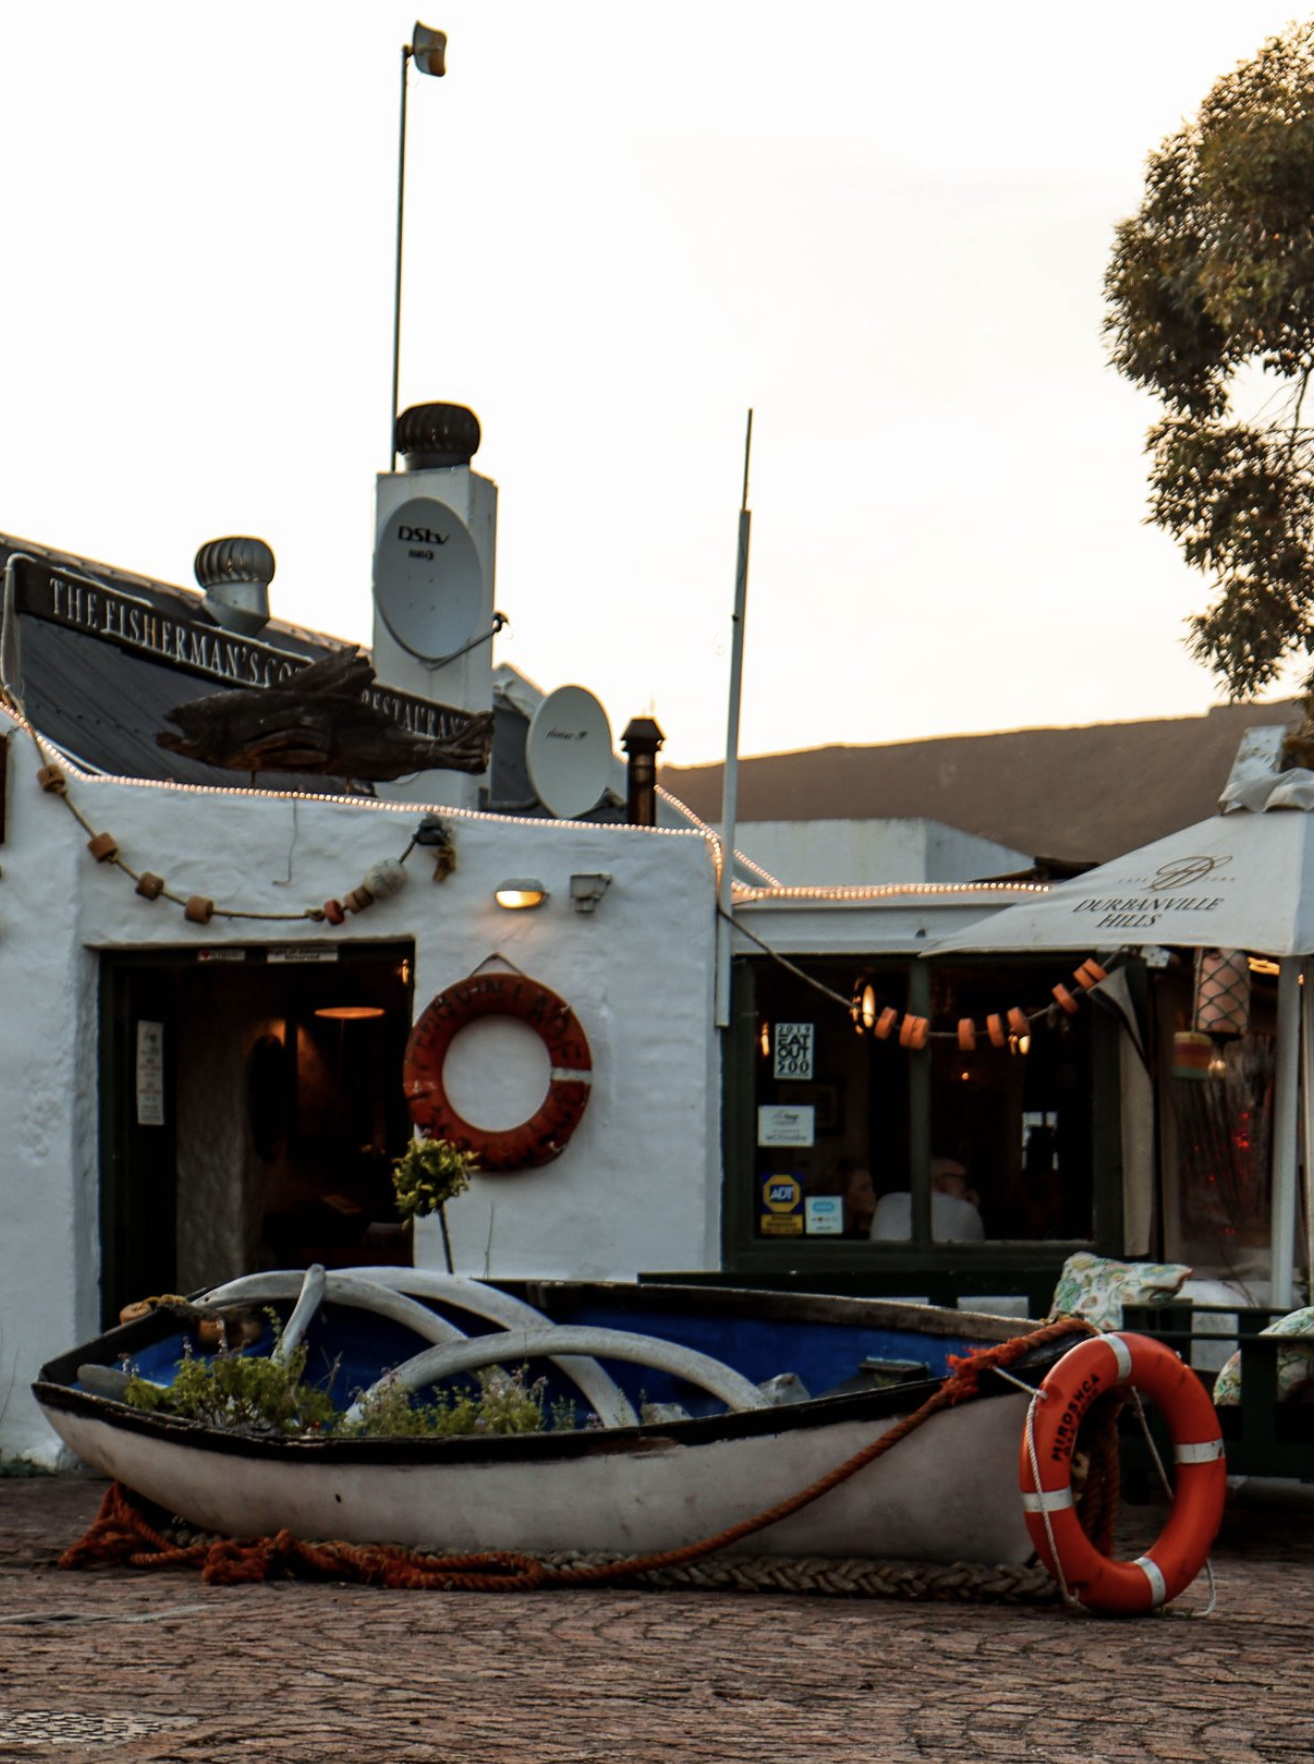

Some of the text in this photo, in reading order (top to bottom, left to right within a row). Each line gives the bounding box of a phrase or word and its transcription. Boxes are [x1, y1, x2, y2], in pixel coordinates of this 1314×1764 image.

[49, 578, 98, 630] THE
[103, 599, 259, 685] FISHERMAN'S
[1072, 897, 1225, 913] DURBANVILLE
[1095, 913, 1163, 928] HILLS
[777, 1033, 811, 1047] EAT
[777, 1046, 811, 1060] OUT
[770, 1186, 794, 1199] ADT
